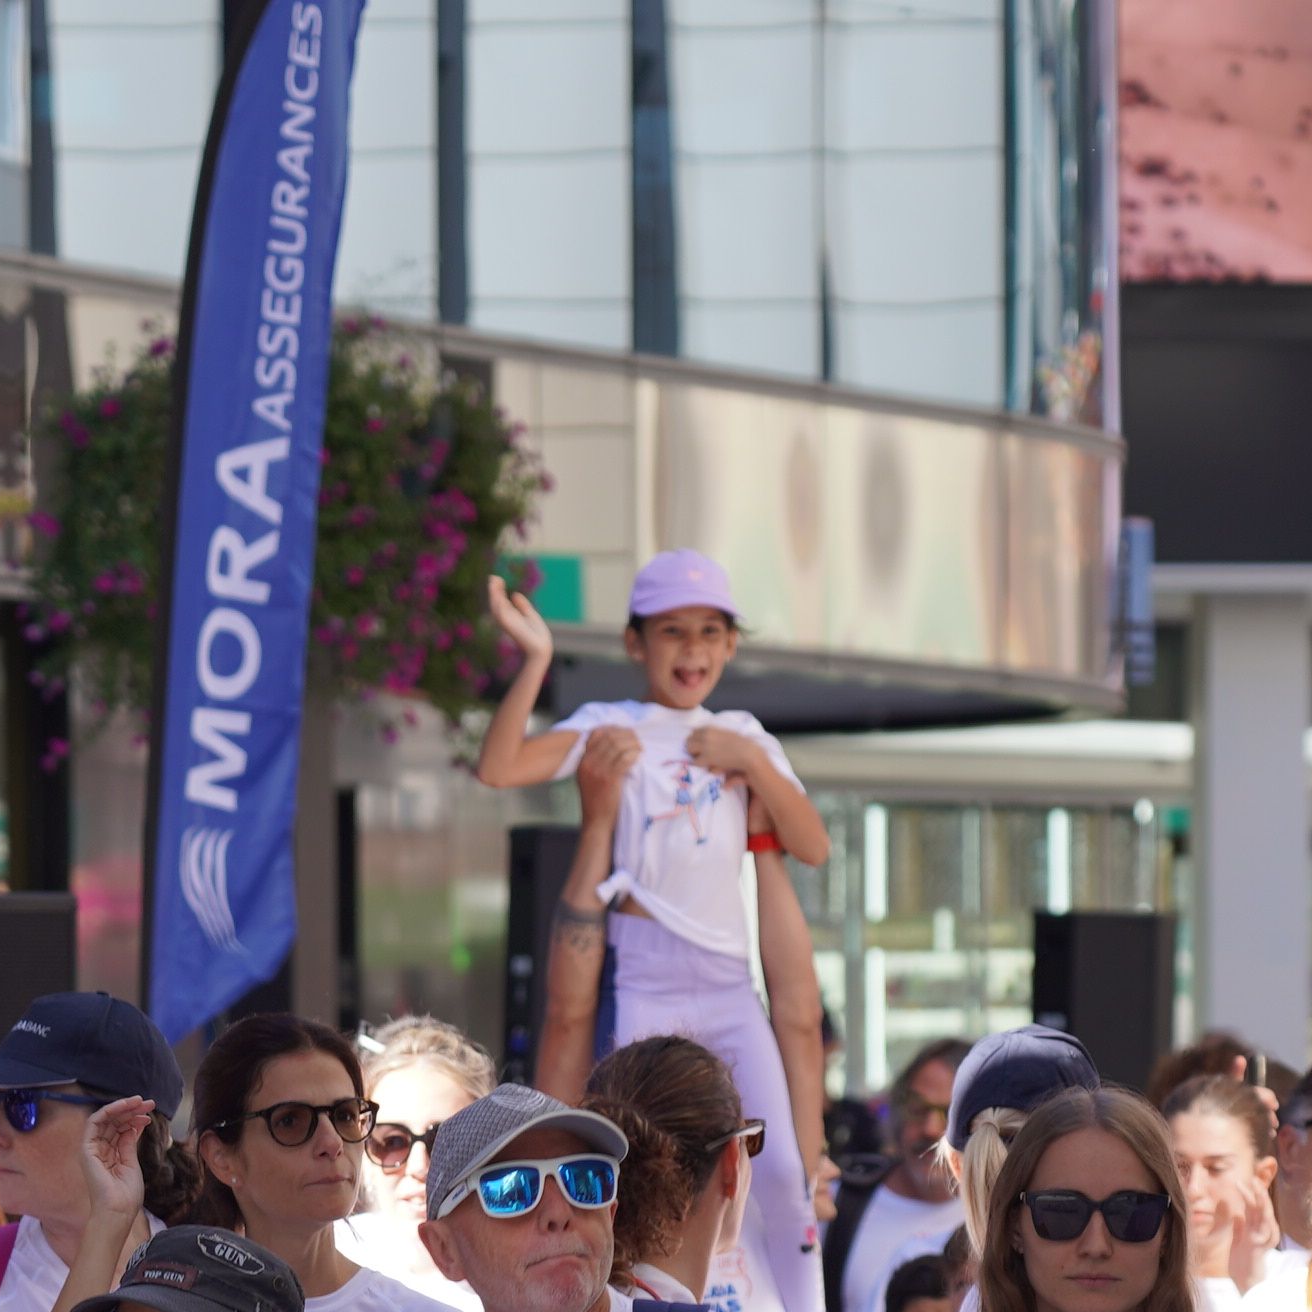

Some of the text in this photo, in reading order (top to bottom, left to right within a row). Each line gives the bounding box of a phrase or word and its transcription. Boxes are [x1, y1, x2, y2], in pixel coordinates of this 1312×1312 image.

[251, 1, 324, 432] ASSEGURANCES
[185, 436, 290, 812] MORA
[144, 1270, 185, 1283] TOP GUN
[214, 1243, 247, 1267] GUN
